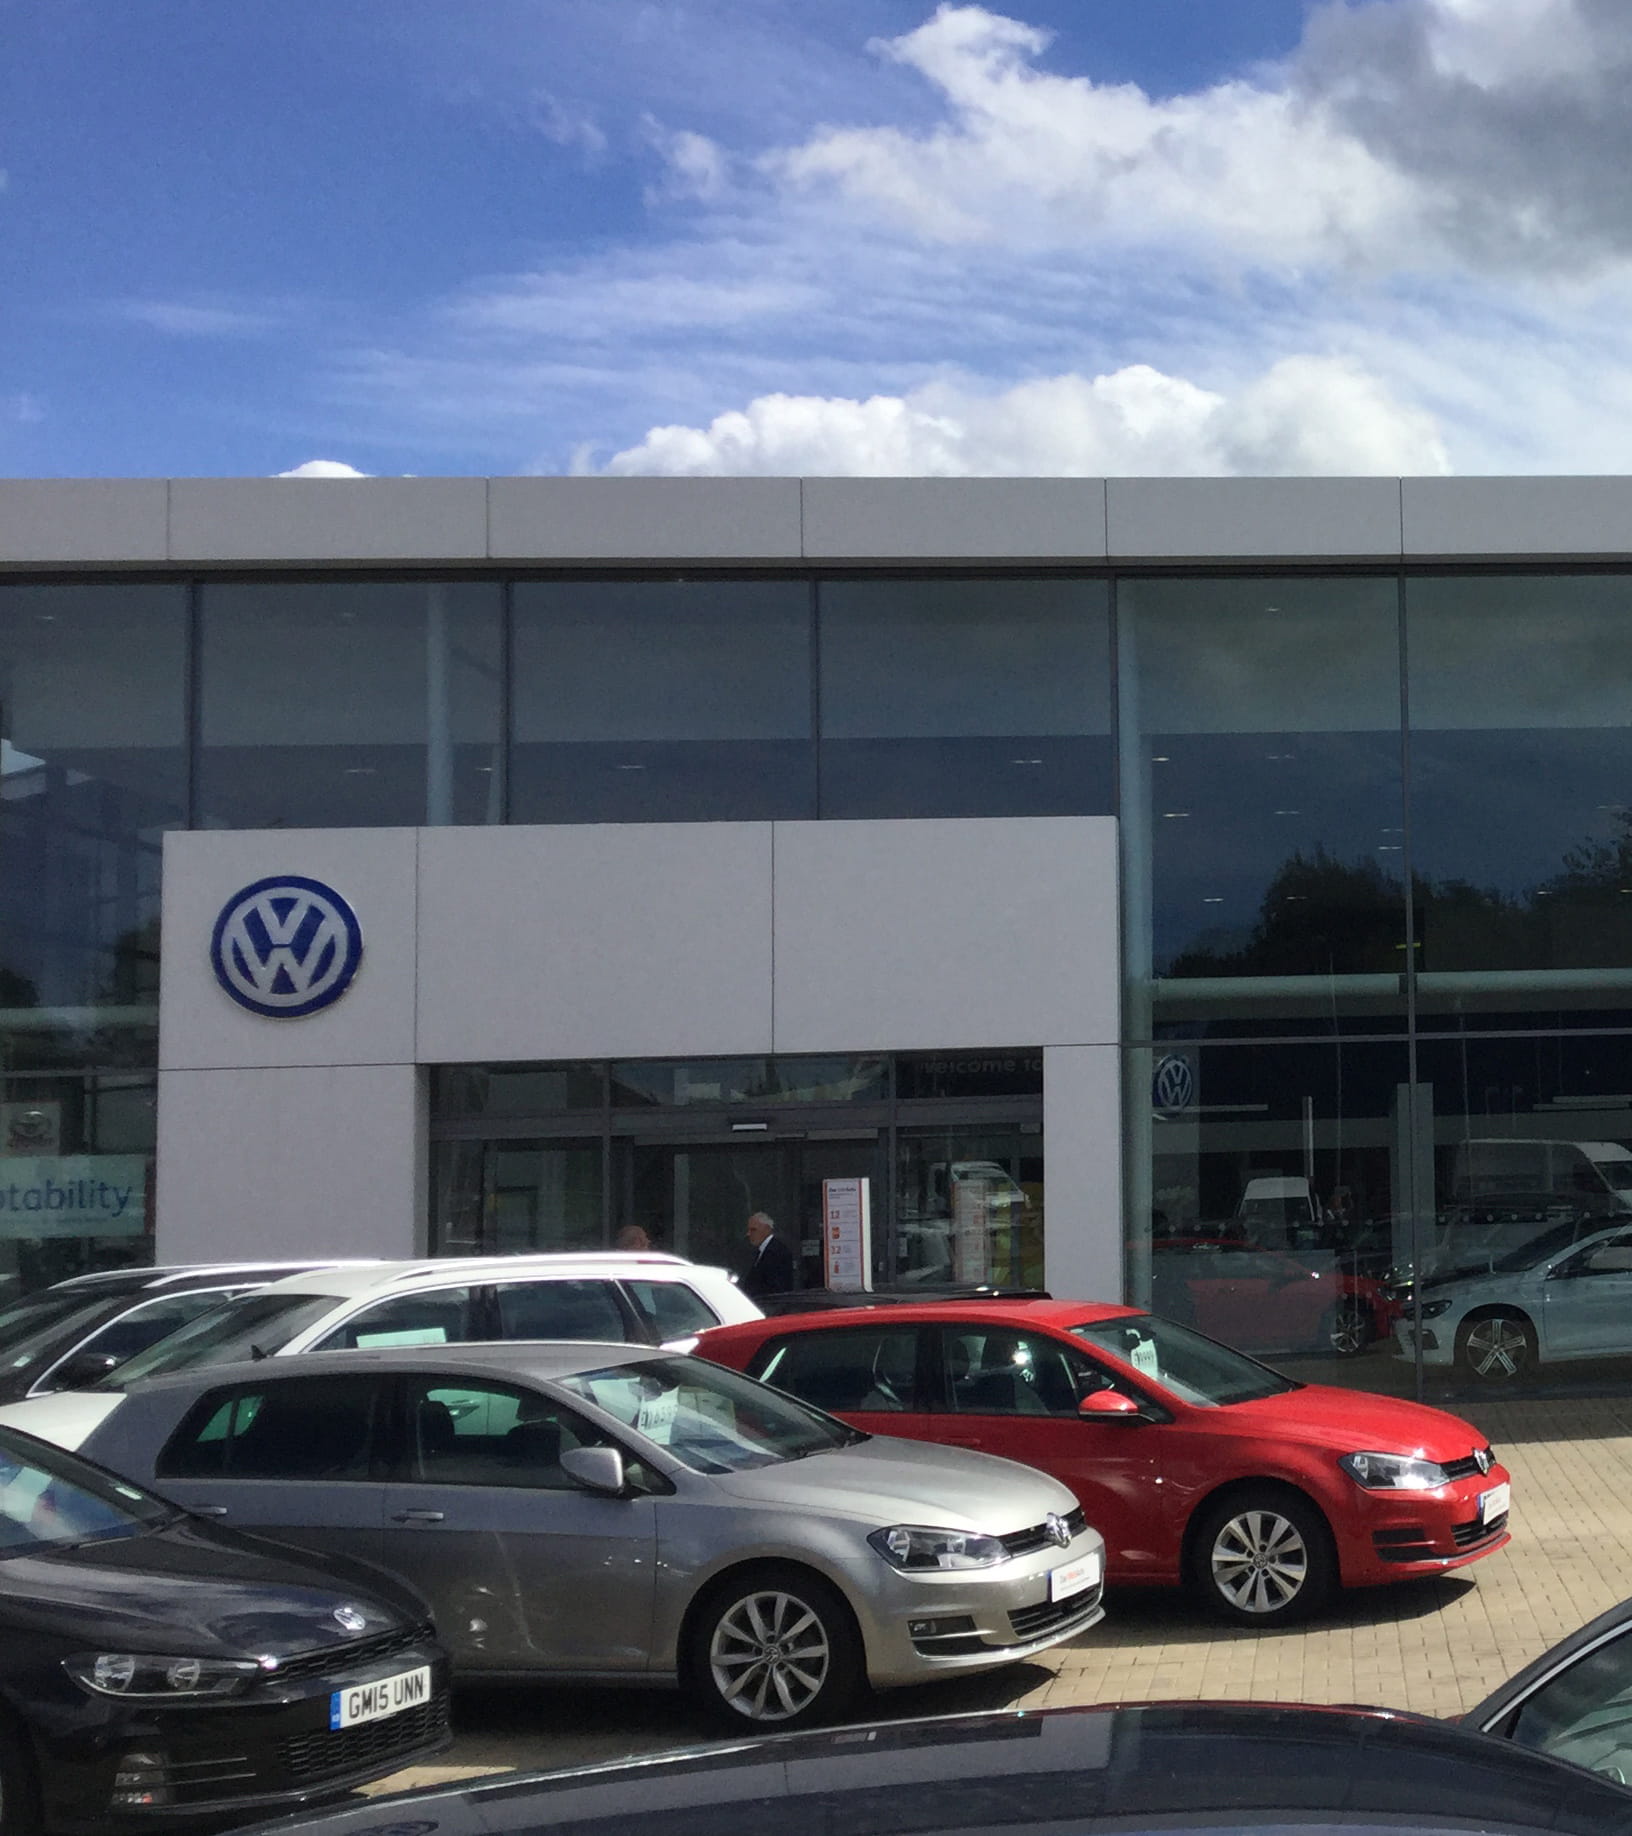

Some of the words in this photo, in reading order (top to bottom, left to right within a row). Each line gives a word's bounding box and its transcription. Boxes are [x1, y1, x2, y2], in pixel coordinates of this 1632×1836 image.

[0, 1179, 133, 1217] tability
[349, 1684, 389, 1719] GM15
[393, 1672, 424, 1706] UNN
